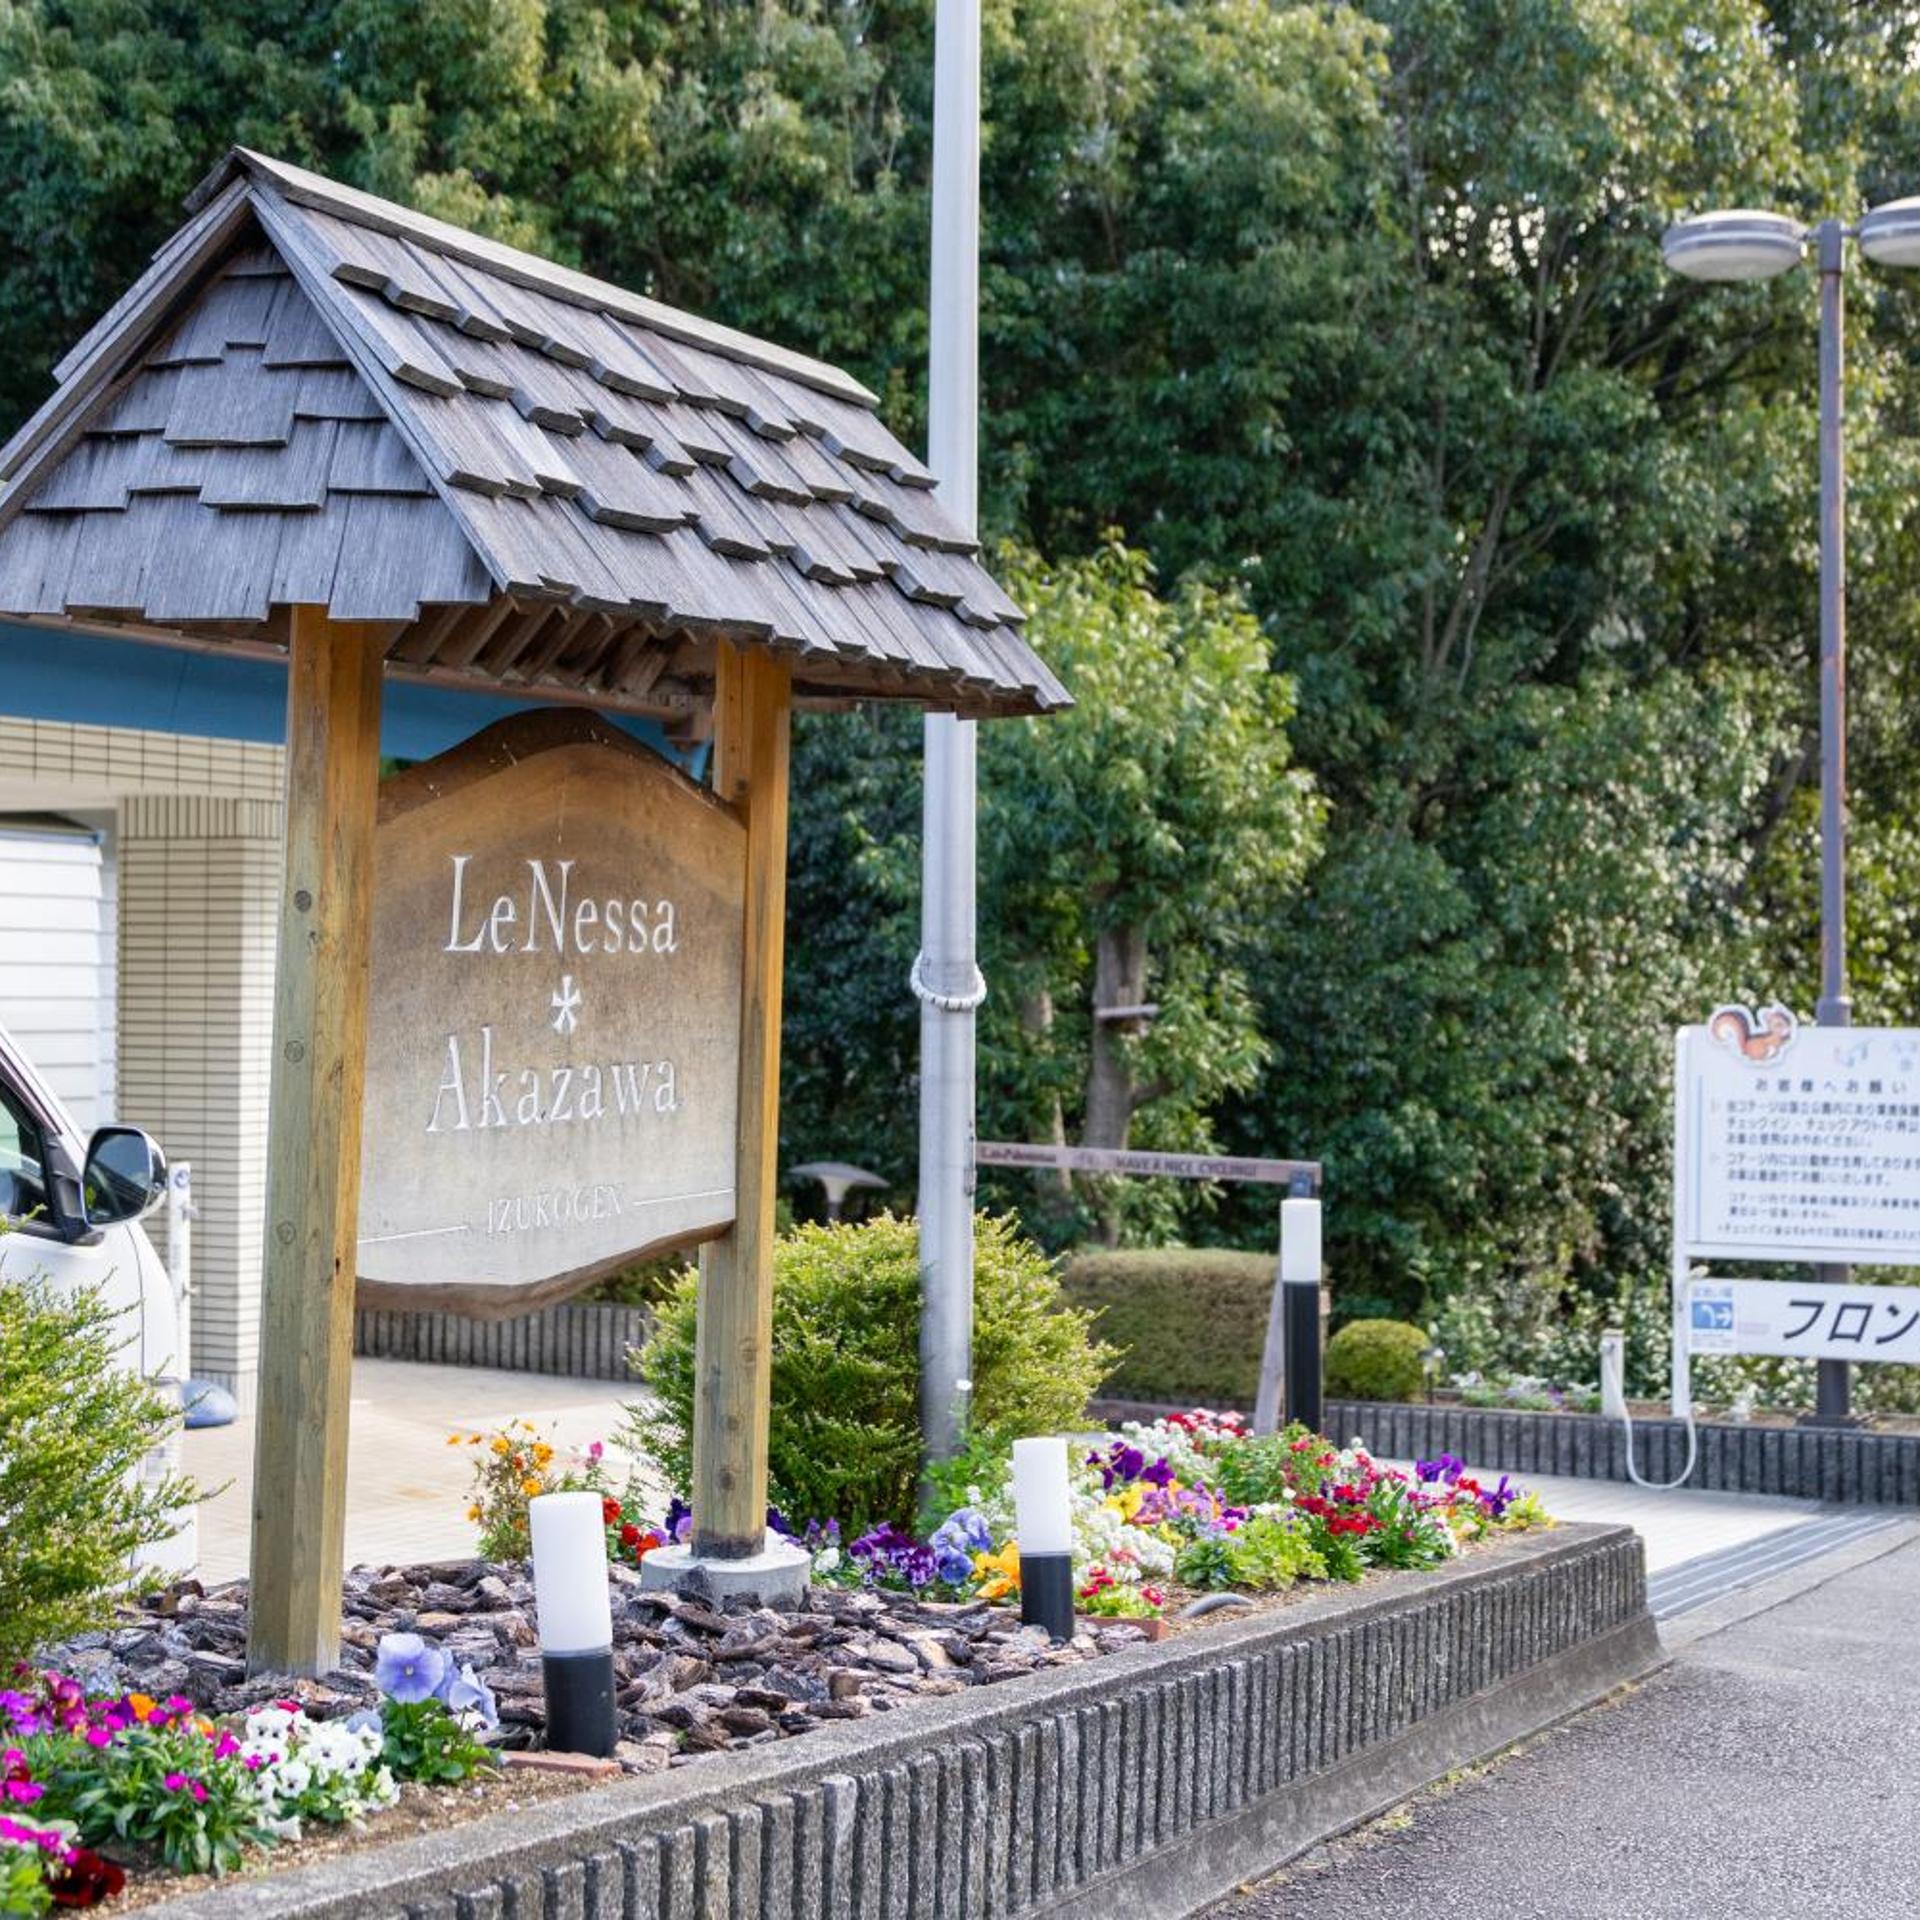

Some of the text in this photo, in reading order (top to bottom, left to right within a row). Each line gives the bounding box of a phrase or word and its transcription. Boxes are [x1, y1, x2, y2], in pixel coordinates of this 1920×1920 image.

[426, 1024, 679, 1132] Akazawa
[486, 1184, 624, 1234] IZUKOGEN
[1783, 1299, 1920, 1345] フロン
